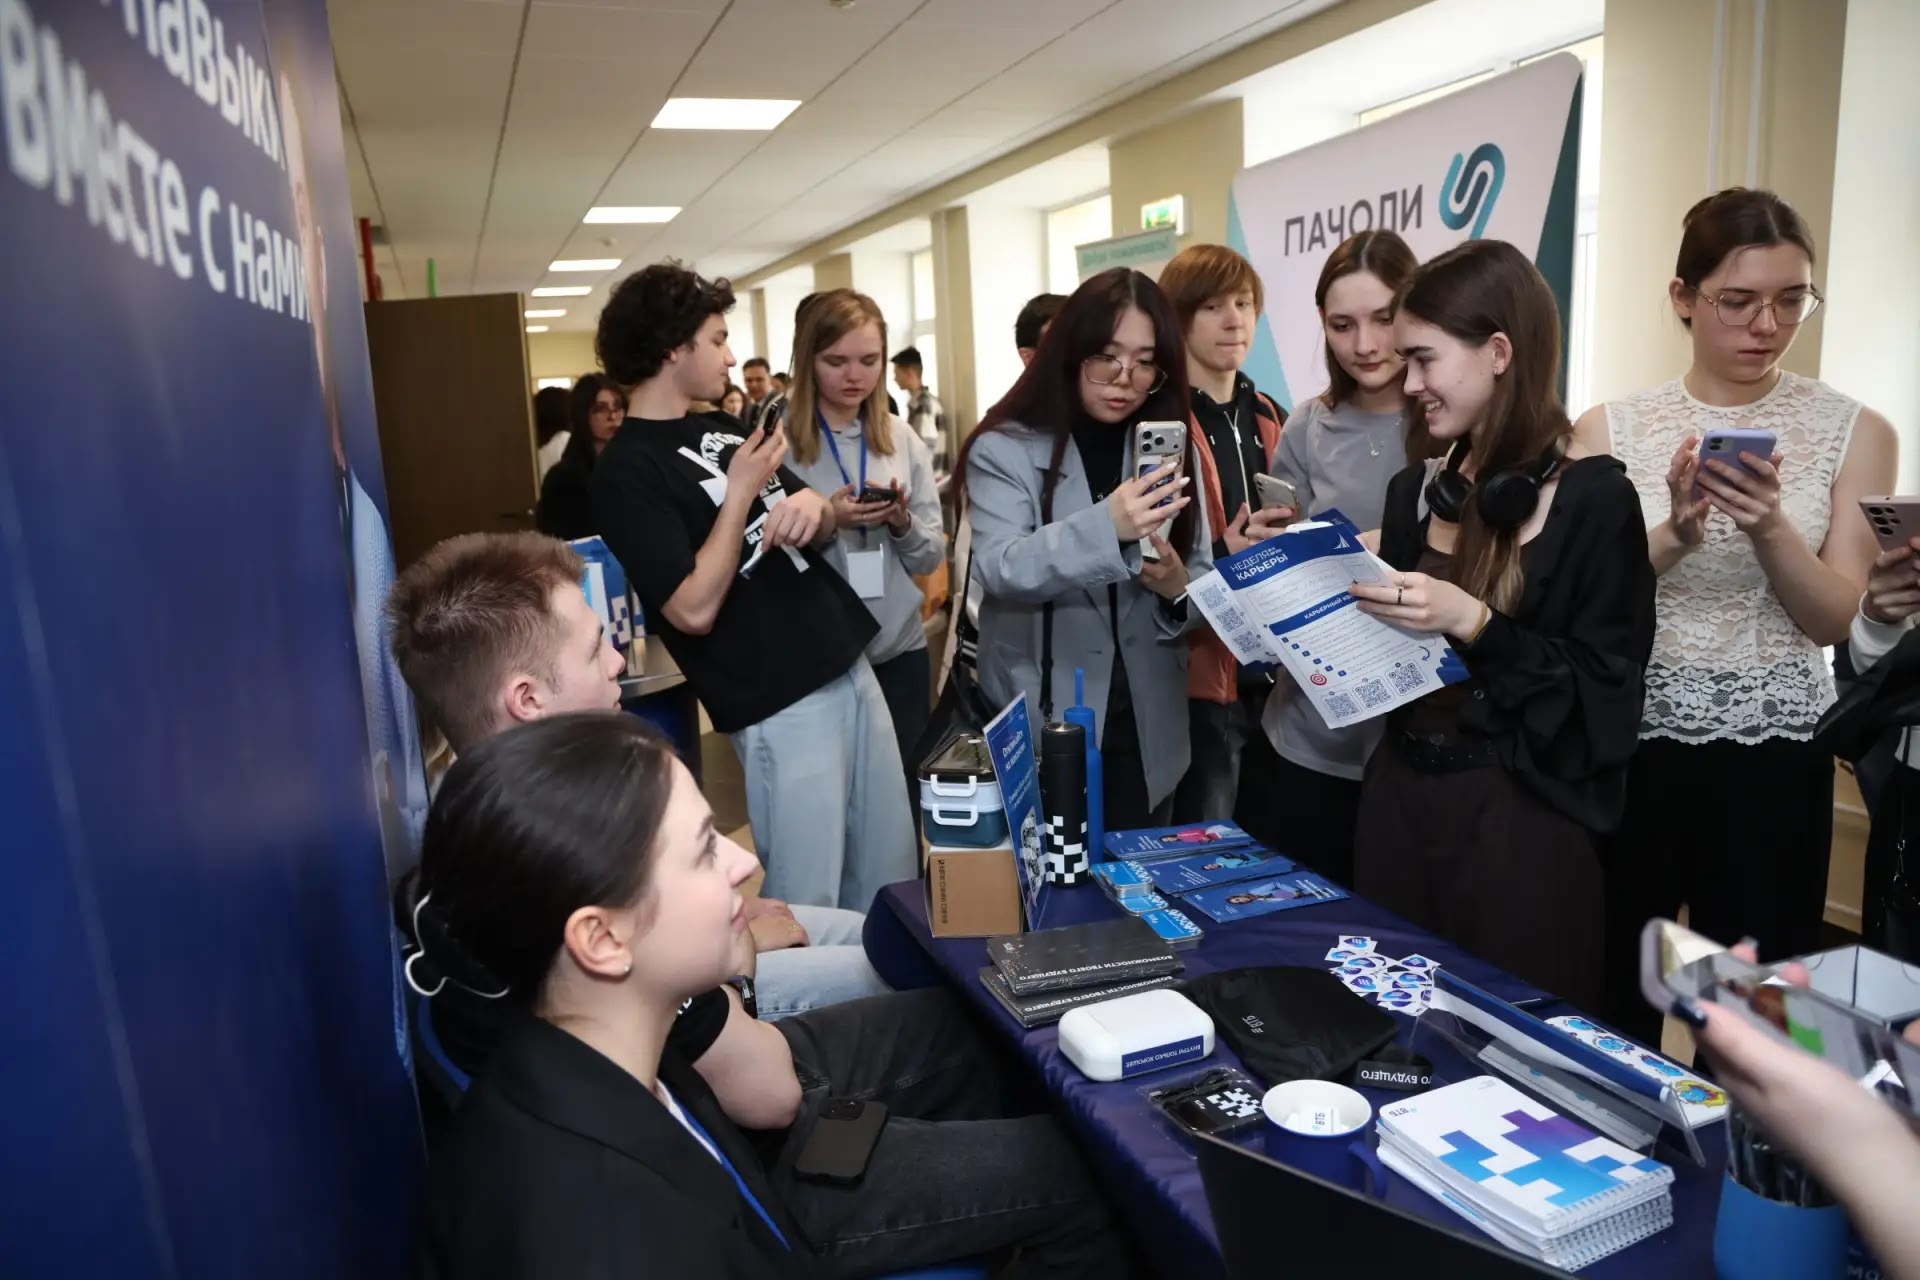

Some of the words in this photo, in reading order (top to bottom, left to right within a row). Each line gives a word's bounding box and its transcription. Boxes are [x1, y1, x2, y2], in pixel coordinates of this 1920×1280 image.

[1284, 184, 1423, 256] ПАЧОЛИ
[199, 186, 226, 293] с
[1229, 549, 1271, 573] НЕДЕЛЯ
[1235, 553, 1289, 581] КАРЬЕРЫ
[1303, 597, 1343, 620] КАРЬЕРНЫЙ
[1069, 964, 1104, 973] ТВОЕГО
[1104, 955, 1174, 968] ВОЗМОЖНОСТИ
[1019, 969, 1068, 981] БУДУЩЕГО
[1106, 975, 1174, 994] ВОЗМОЖНОСТИ
[1073, 990, 1107, 1001] ТВОЕГО
[1024, 998, 1073, 1012] БУДУЩЕГО
[1241, 1015, 1265, 1029] ВТБ
[1154, 1050, 1178, 1061] ТОЛЬКО
[1178, 1044, 1201, 1055] ВНУТРИ
[1361, 1070, 1418, 1084] БУДУЩЕГО
